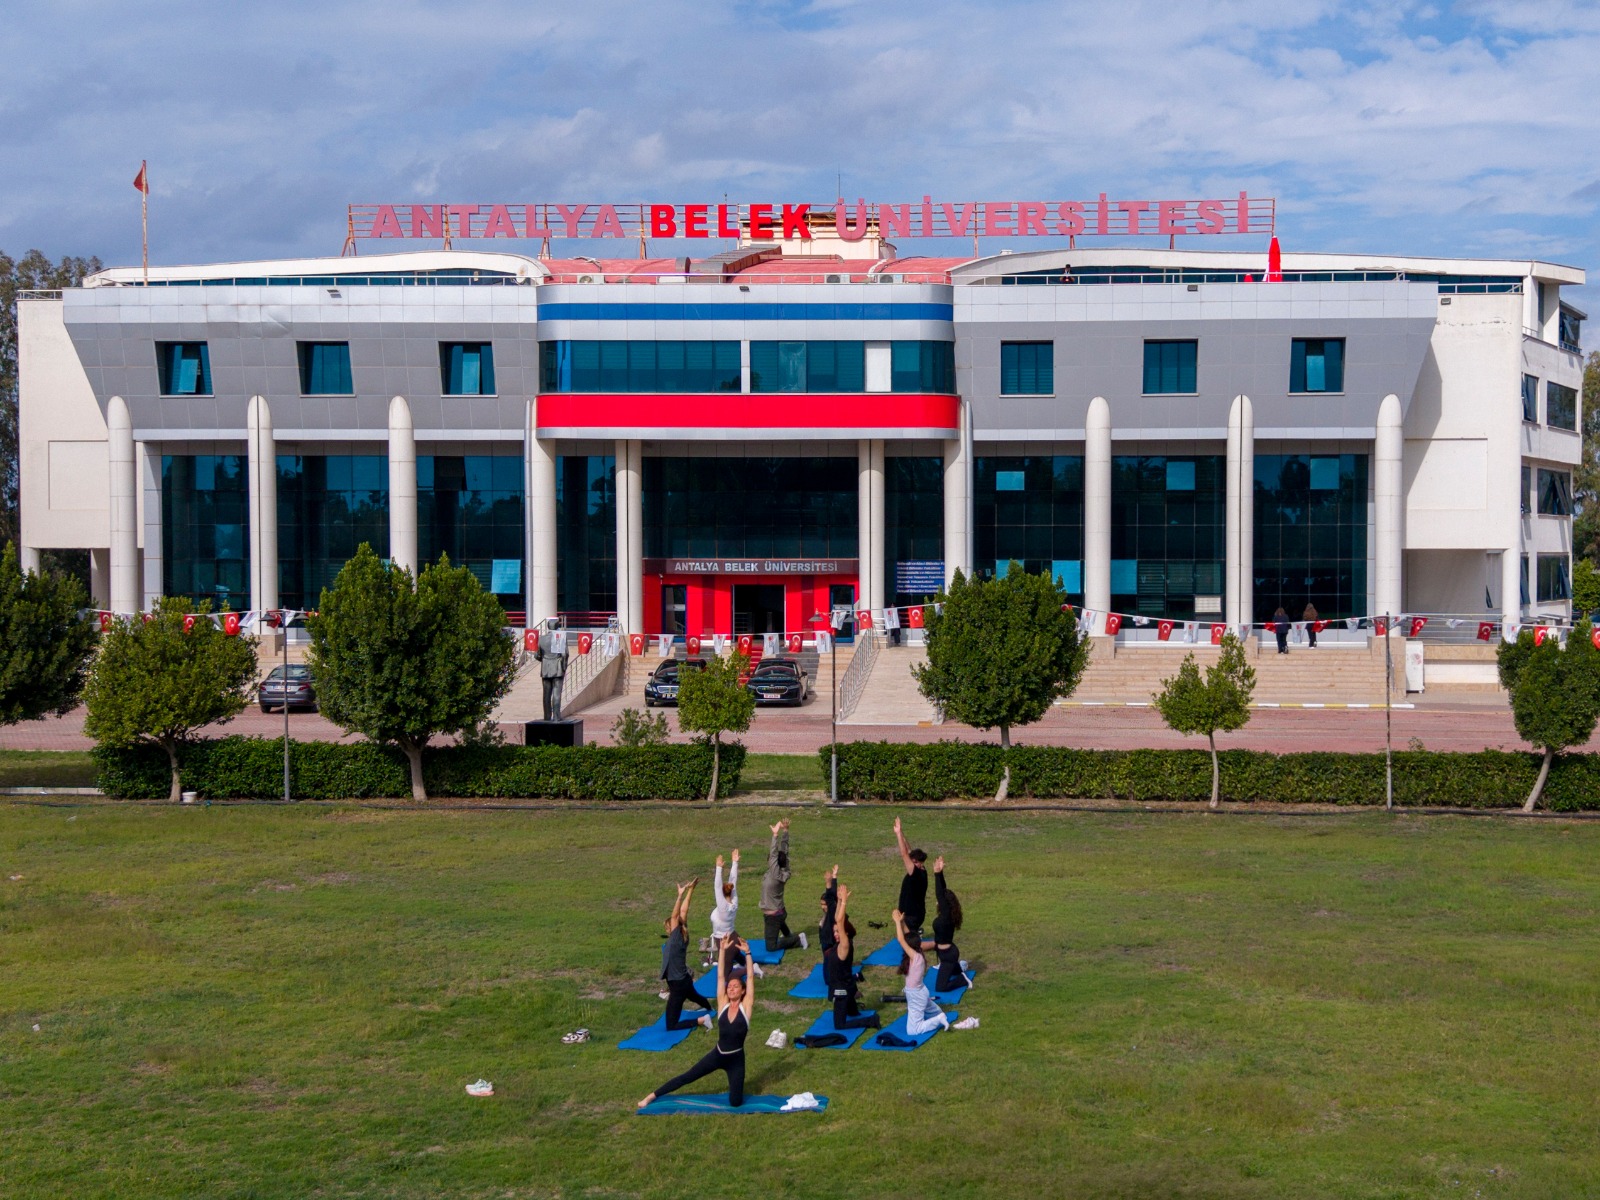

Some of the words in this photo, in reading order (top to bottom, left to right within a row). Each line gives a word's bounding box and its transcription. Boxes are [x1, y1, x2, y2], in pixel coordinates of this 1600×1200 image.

[370, 204, 626, 238] ANTALYA
[650, 203, 812, 239] BELEK
[835, 191, 1248, 242] ÜNİVERSİTESİ
[674, 562, 719, 572] ANTALYA
[724, 562, 759, 572] BELEK
[764, 560, 838, 572] ÜNİVERSİTESİ
